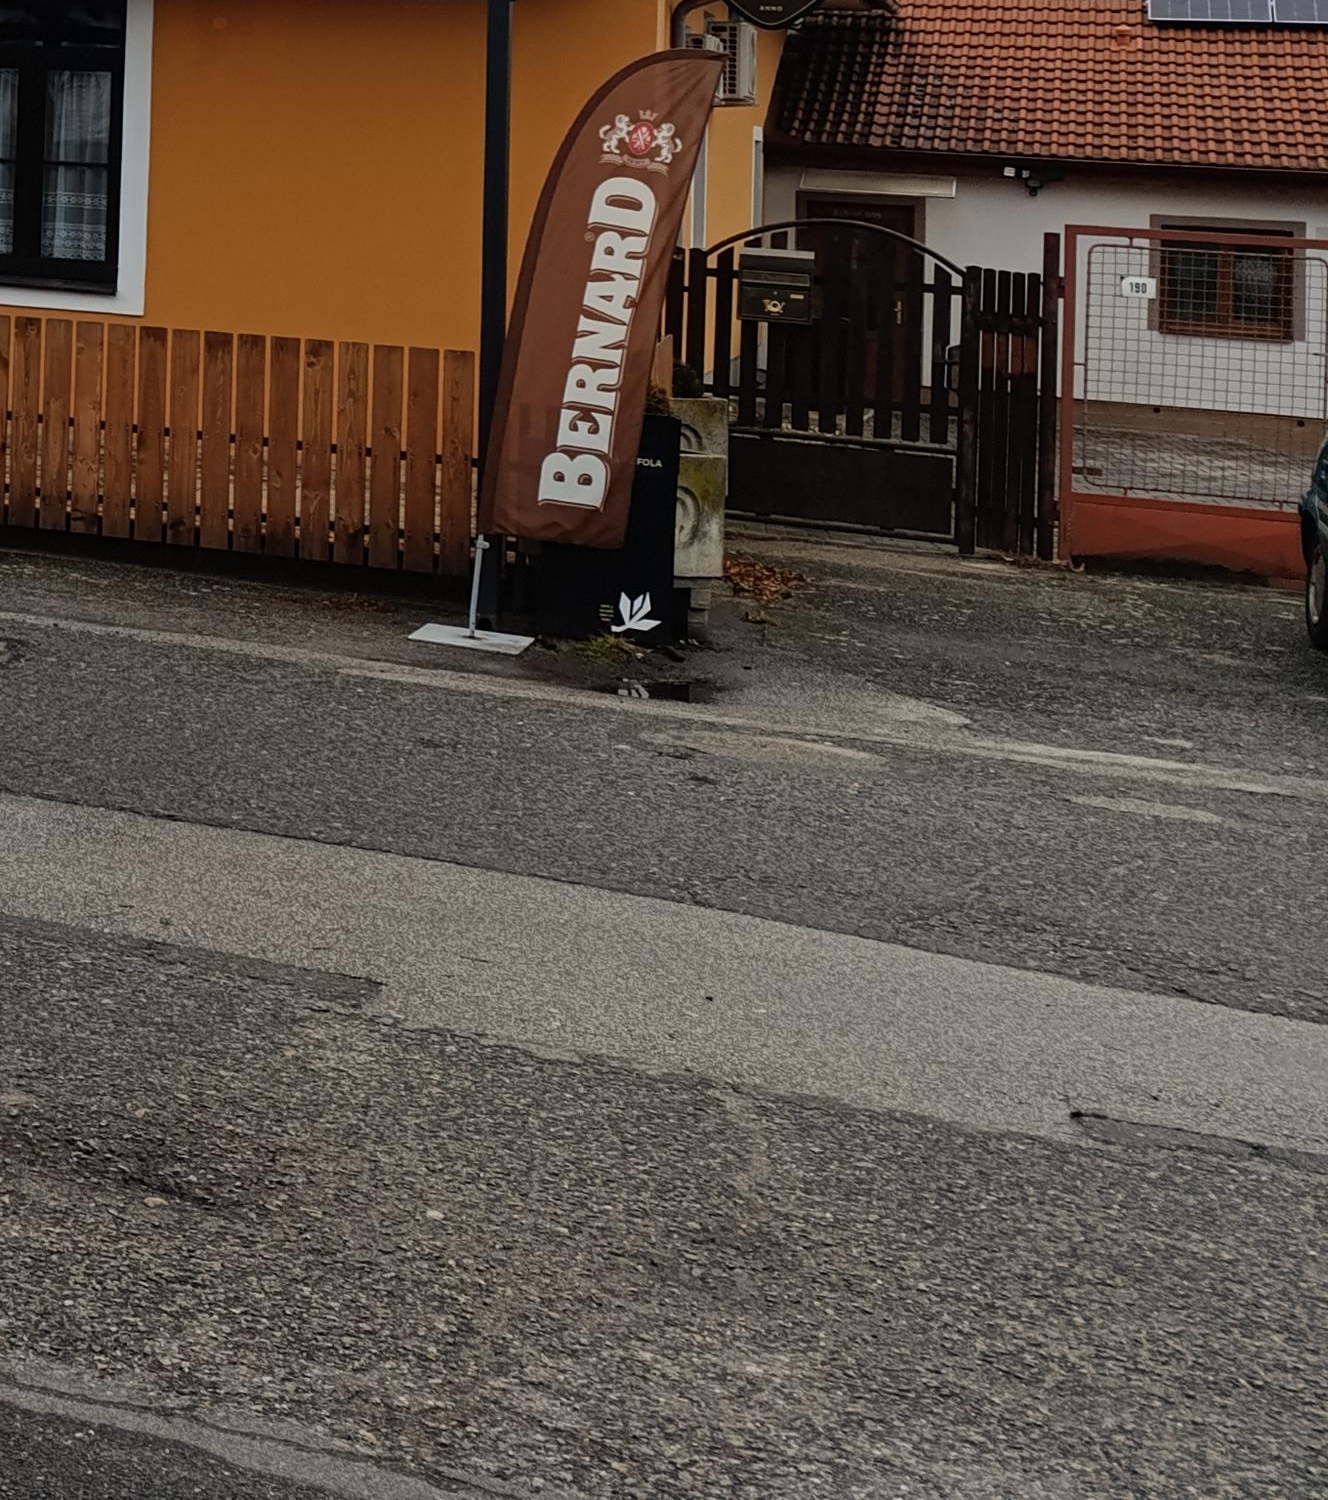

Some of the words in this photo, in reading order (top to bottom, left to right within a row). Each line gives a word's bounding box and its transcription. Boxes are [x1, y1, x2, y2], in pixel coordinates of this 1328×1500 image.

[1129, 282, 1147, 294] 190
[537, 176, 659, 512] BERNARD
[637, 457, 663, 468] FOLA
